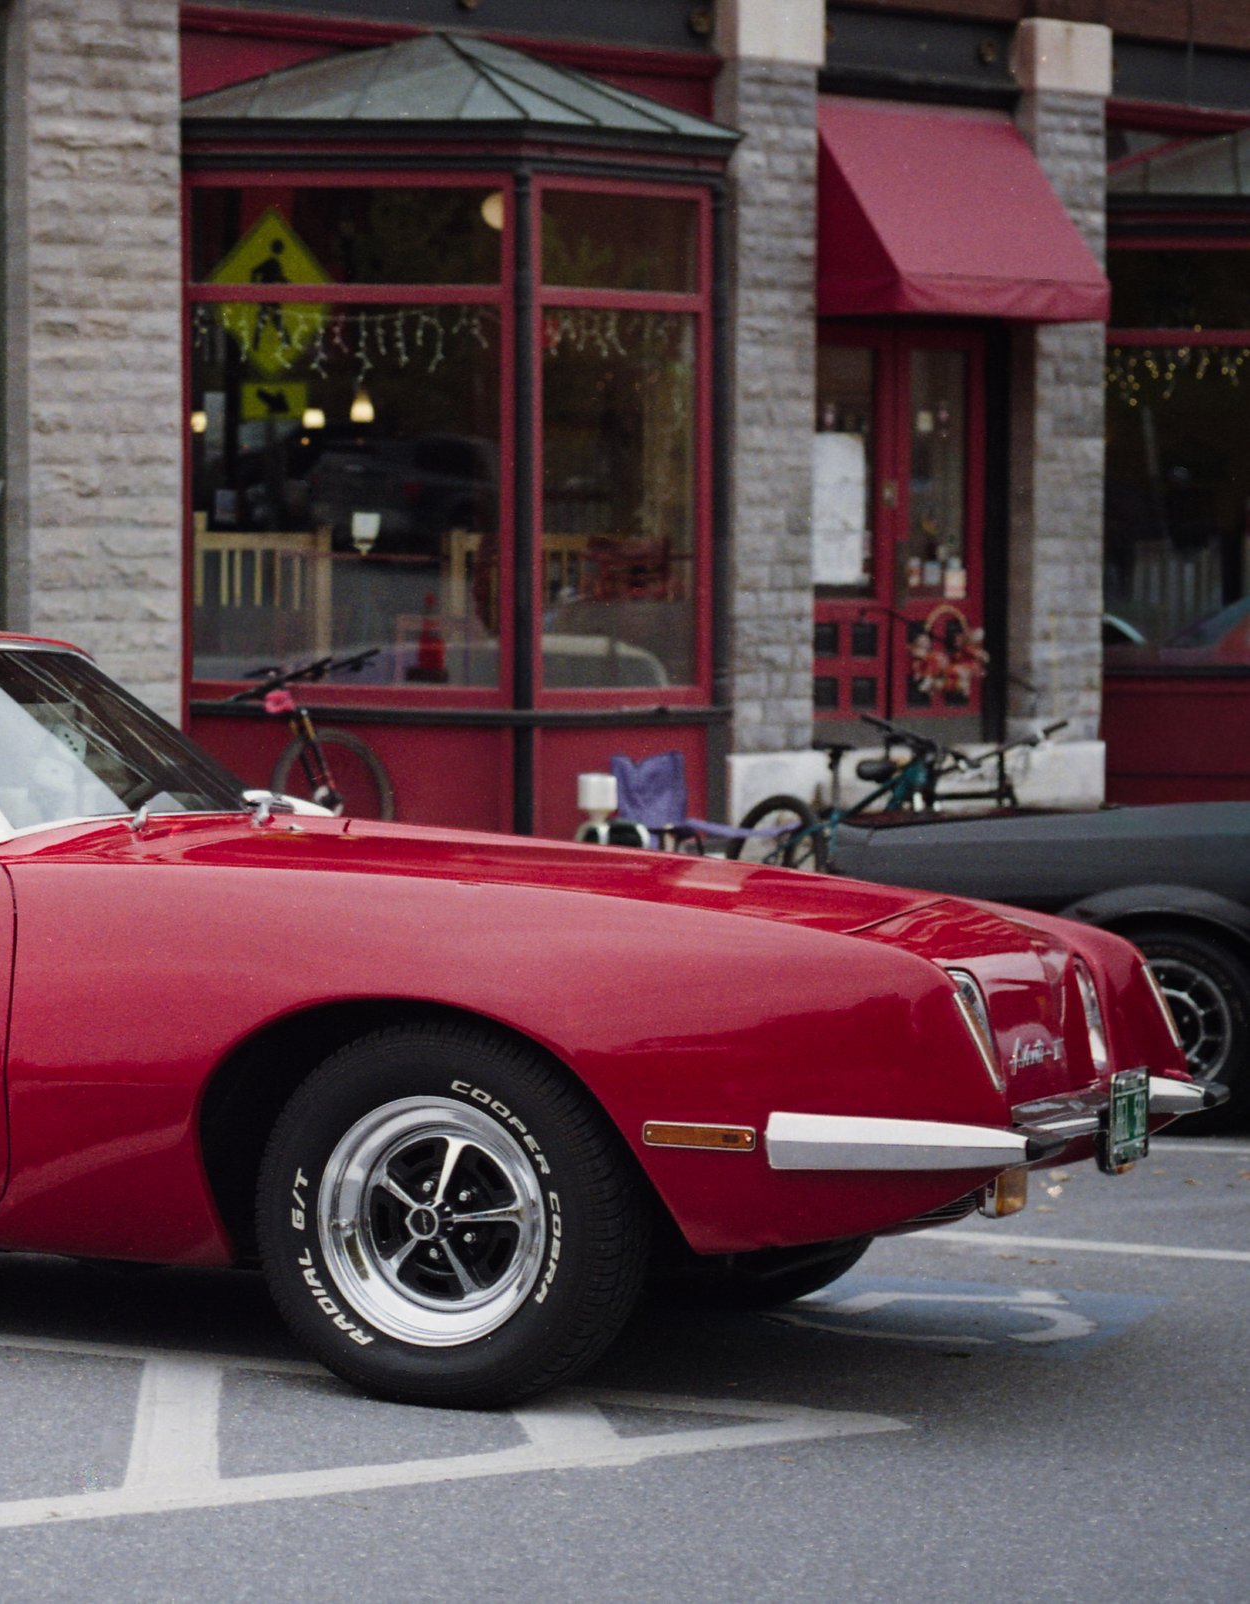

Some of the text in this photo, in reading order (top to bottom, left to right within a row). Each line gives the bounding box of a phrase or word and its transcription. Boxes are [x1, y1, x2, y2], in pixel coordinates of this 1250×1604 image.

[291, 1167, 374, 1345] RADIAL G/T
[451, 1079, 562, 1304] COOPER COBRA
